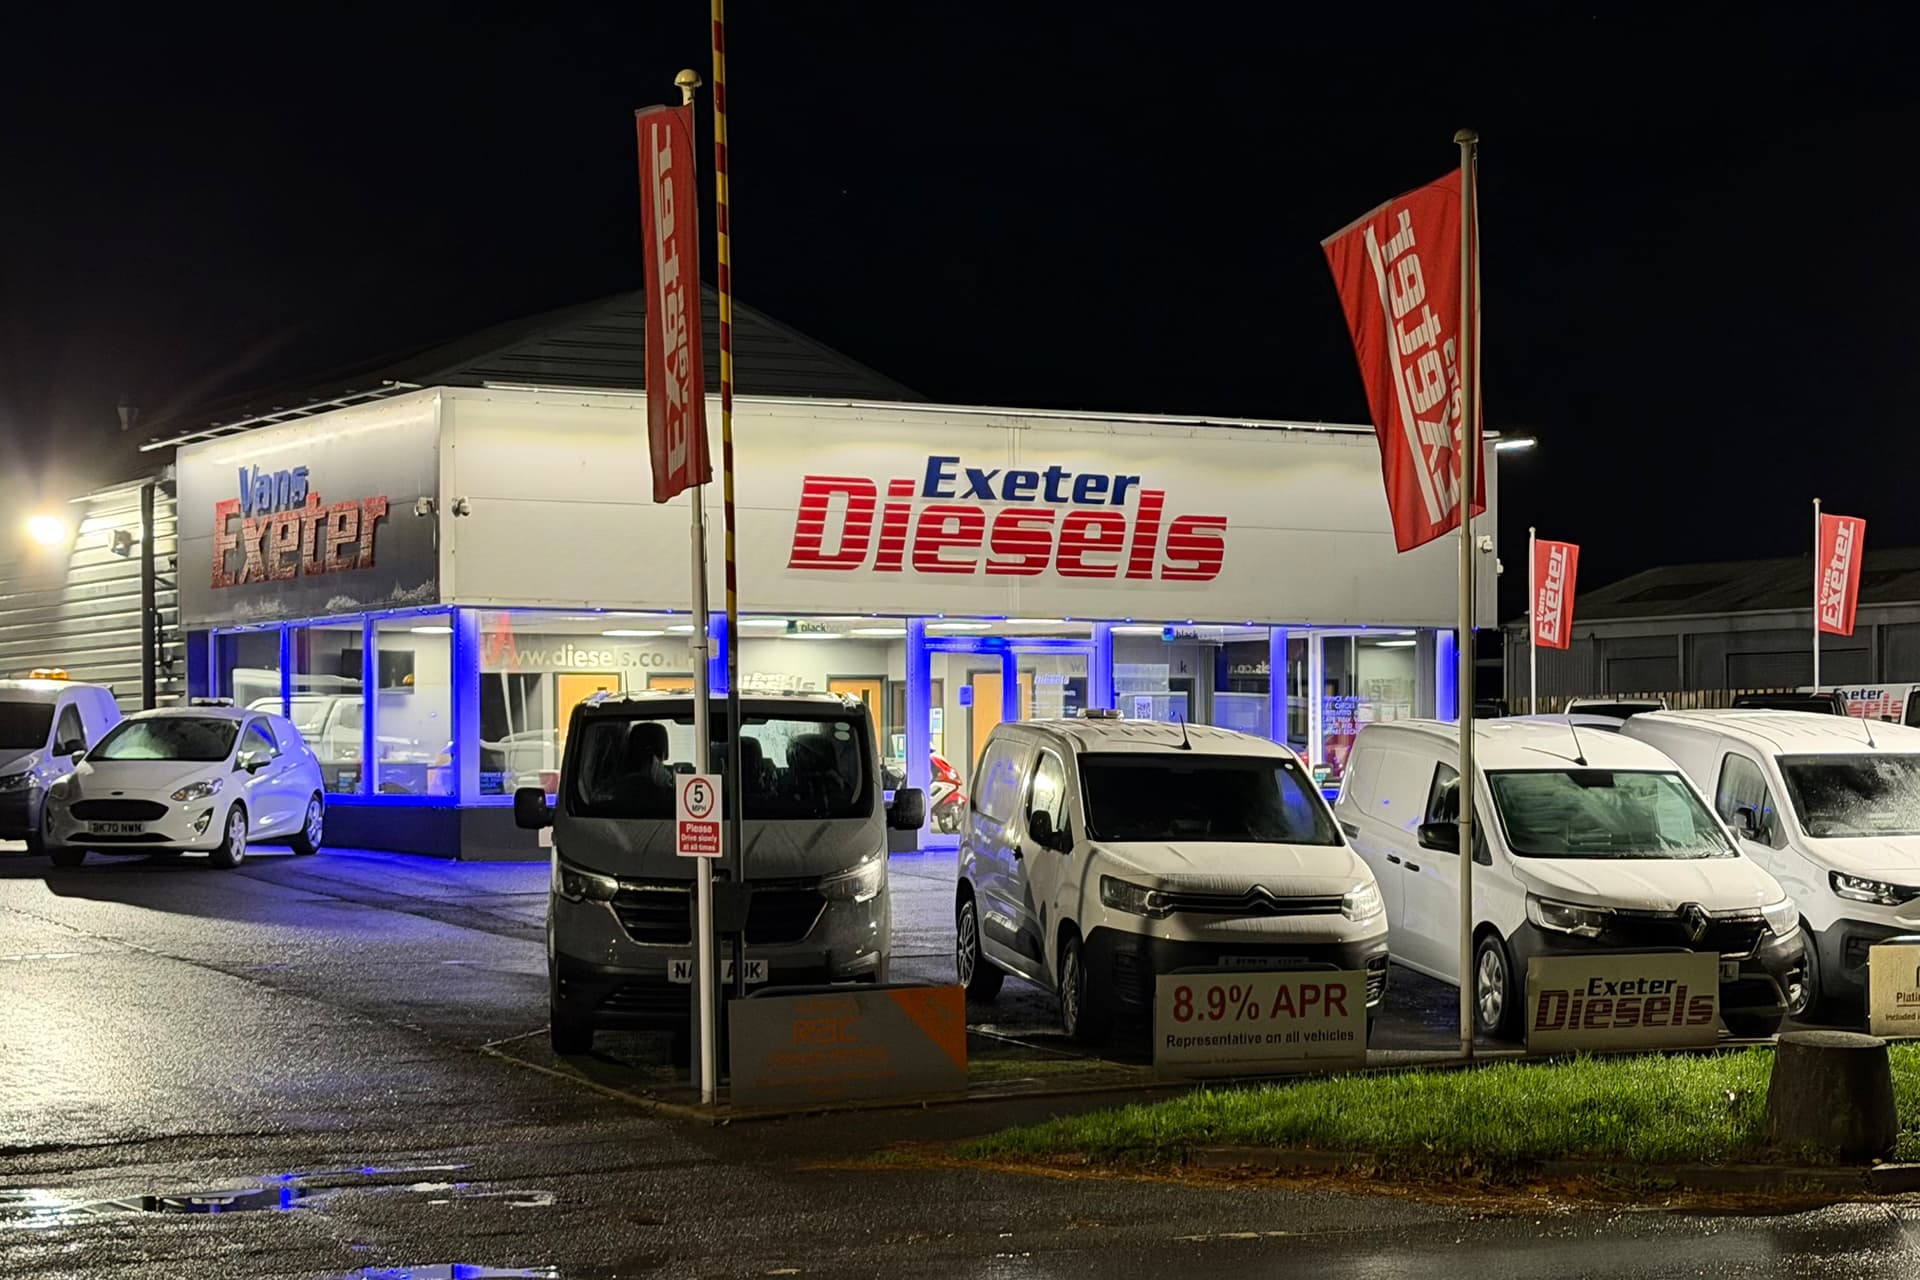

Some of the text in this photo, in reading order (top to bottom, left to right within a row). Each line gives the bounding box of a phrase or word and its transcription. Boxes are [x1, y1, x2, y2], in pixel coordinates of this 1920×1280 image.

[238, 464, 310, 515] Vans
[921, 455, 1140, 506] Exeter
[210, 491, 389, 590] Exeter
[786, 475, 1229, 582] Diesels
[1822, 520, 1850, 628] Exeter
[1536, 587, 1546, 622] Vans
[1538, 545, 1562, 641] Exeter
[691, 804, 707, 812] MPH
[693, 784, 704, 804] 5
[681, 833, 697, 841] Drive
[685, 823, 713, 833] Please
[699, 843, 716, 851] times
[1172, 983, 1349, 1023] 8.9% APR
[1586, 977, 1679, 997] Exeter
[1535, 985, 1715, 1032] Diesels
[1165, 1032, 1262, 1049] Representative
[1265, 1033, 1282, 1045] on
[1285, 1031, 1300, 1044] all
